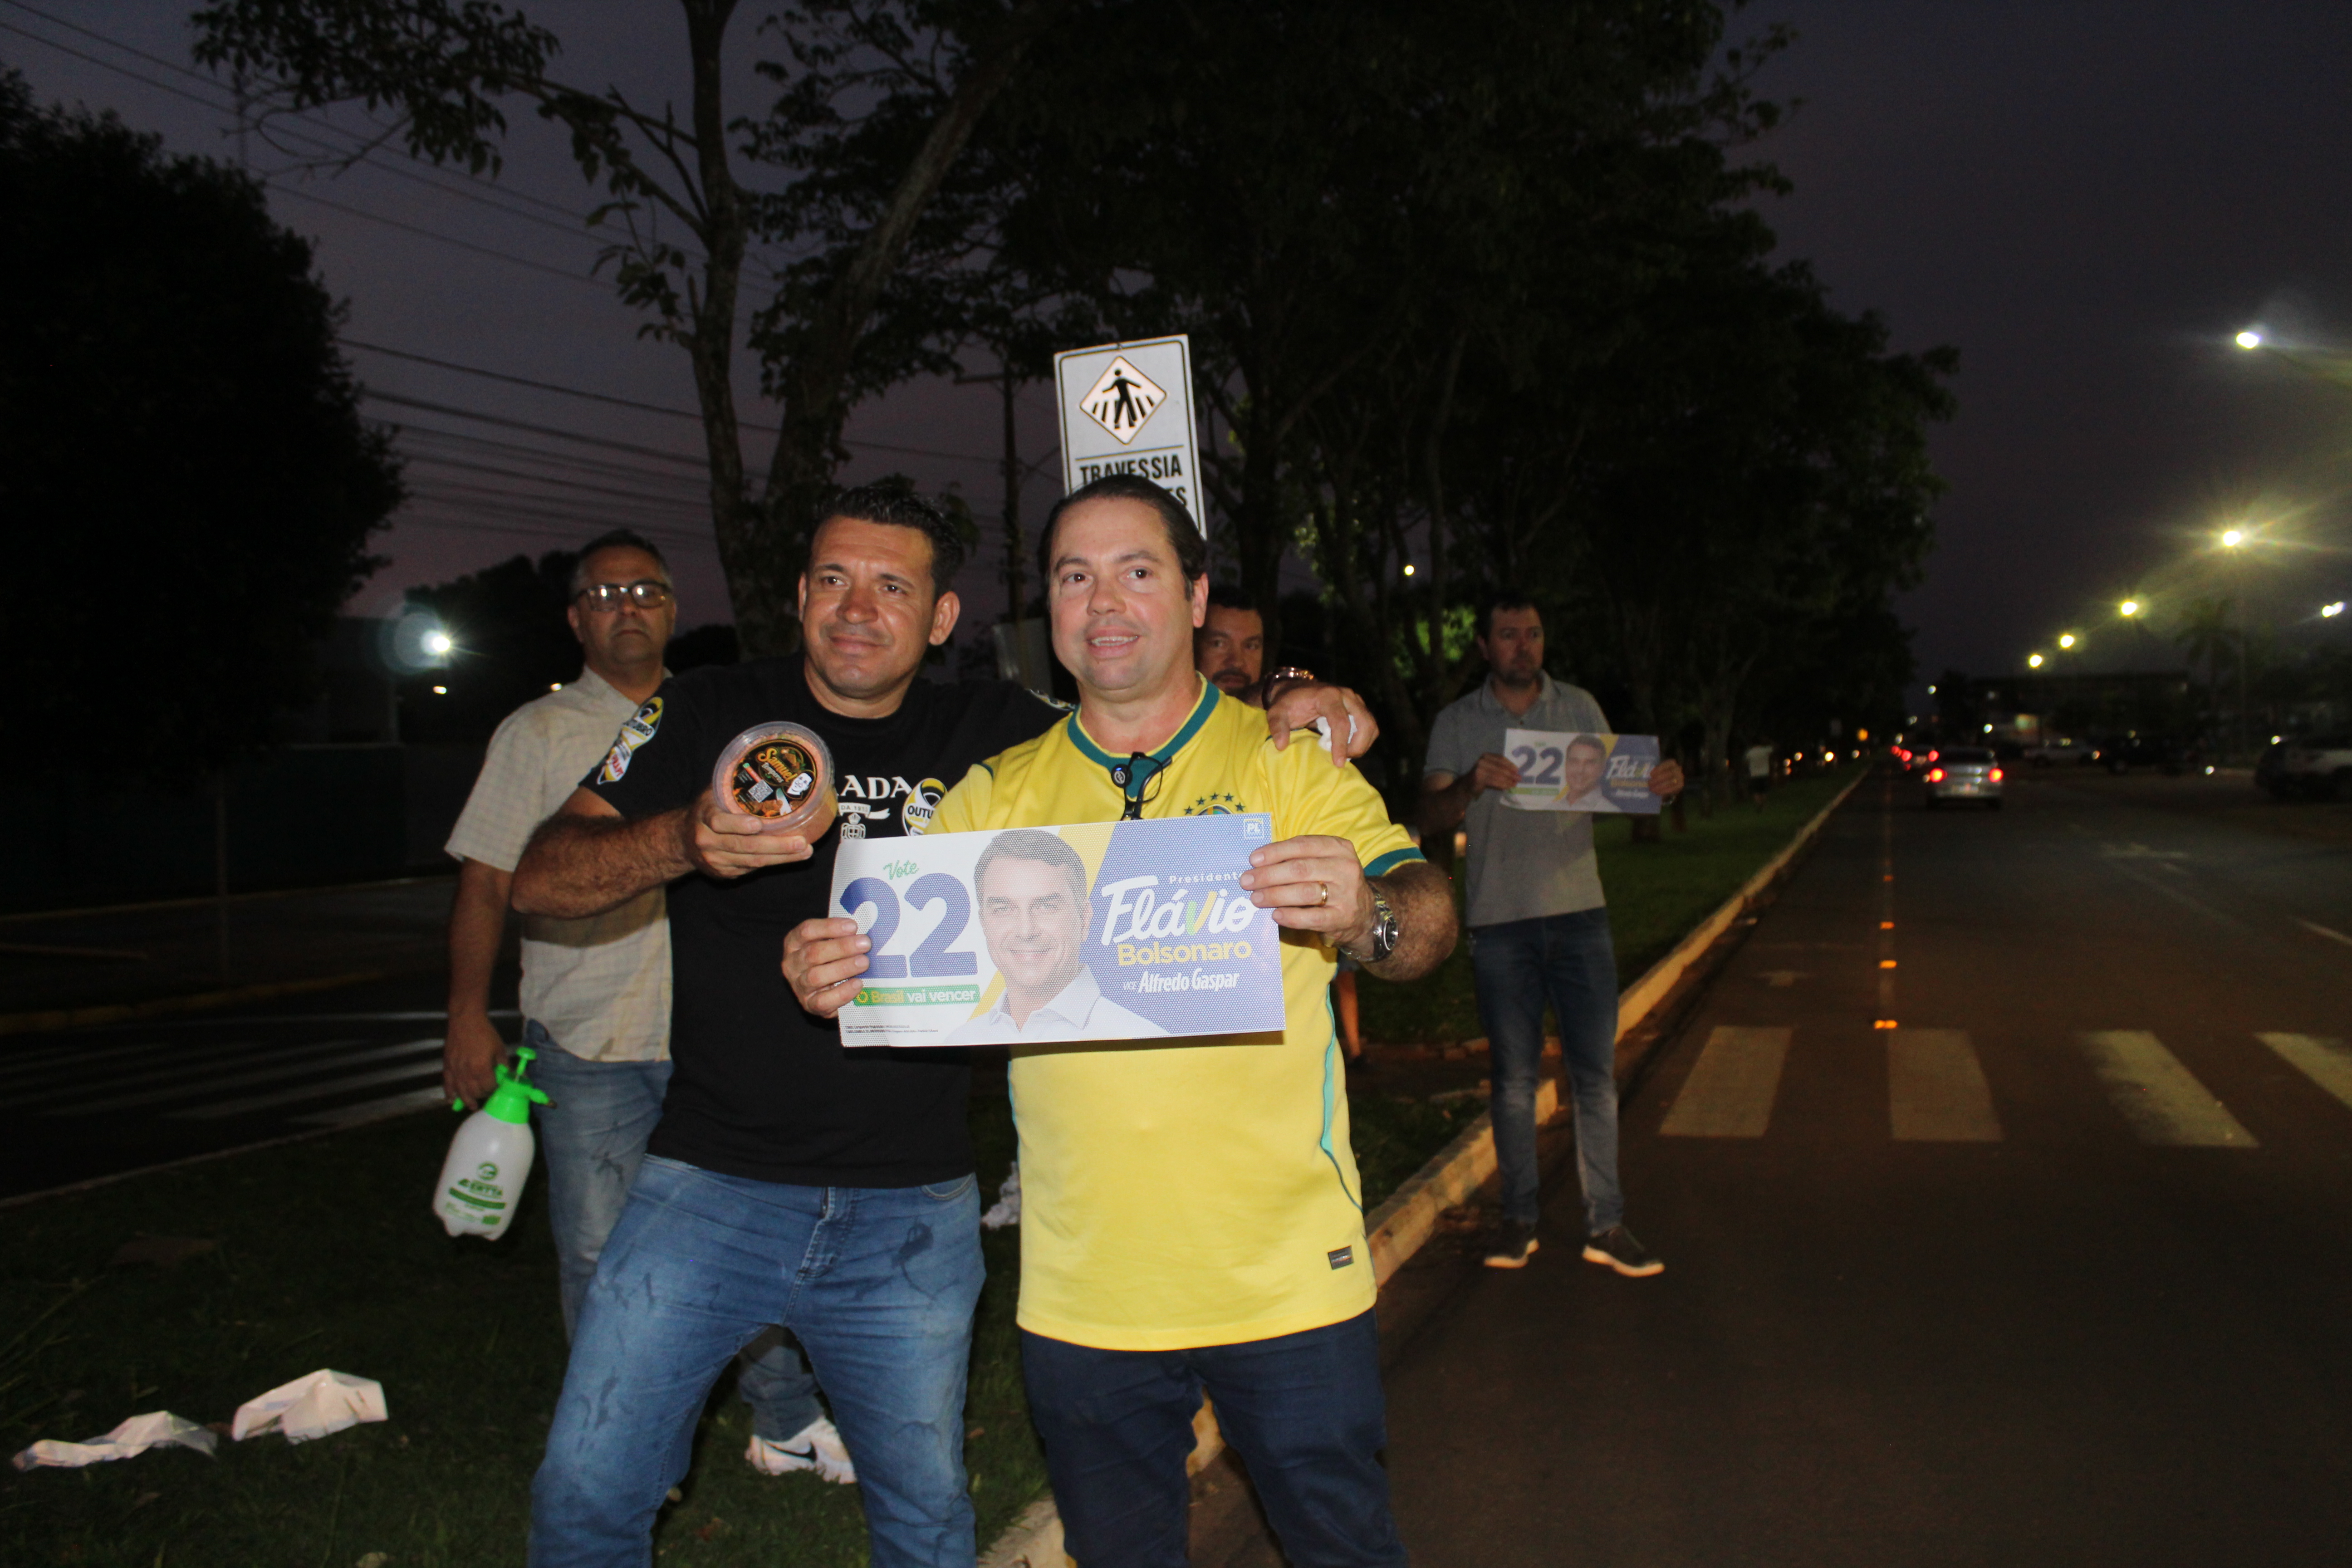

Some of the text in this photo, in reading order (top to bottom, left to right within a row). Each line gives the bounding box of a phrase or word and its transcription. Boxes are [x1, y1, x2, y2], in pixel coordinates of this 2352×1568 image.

[757, 747, 798, 783] Samuel
[1512, 745, 1563, 784] 22
[1247, 823, 1261, 834] PL
[883, 860, 920, 880] Vote
[1169, 871, 1242, 884] President
[1101, 875, 1260, 946] Flávio
[840, 872, 978, 979] 22
[1117, 941, 1252, 966] Bolsonaro
[1137, 970, 1189, 994] Alfredo
[1191, 967, 1240, 992] Gaspar
[857, 989, 976, 1004] O Brasil vai vencer
